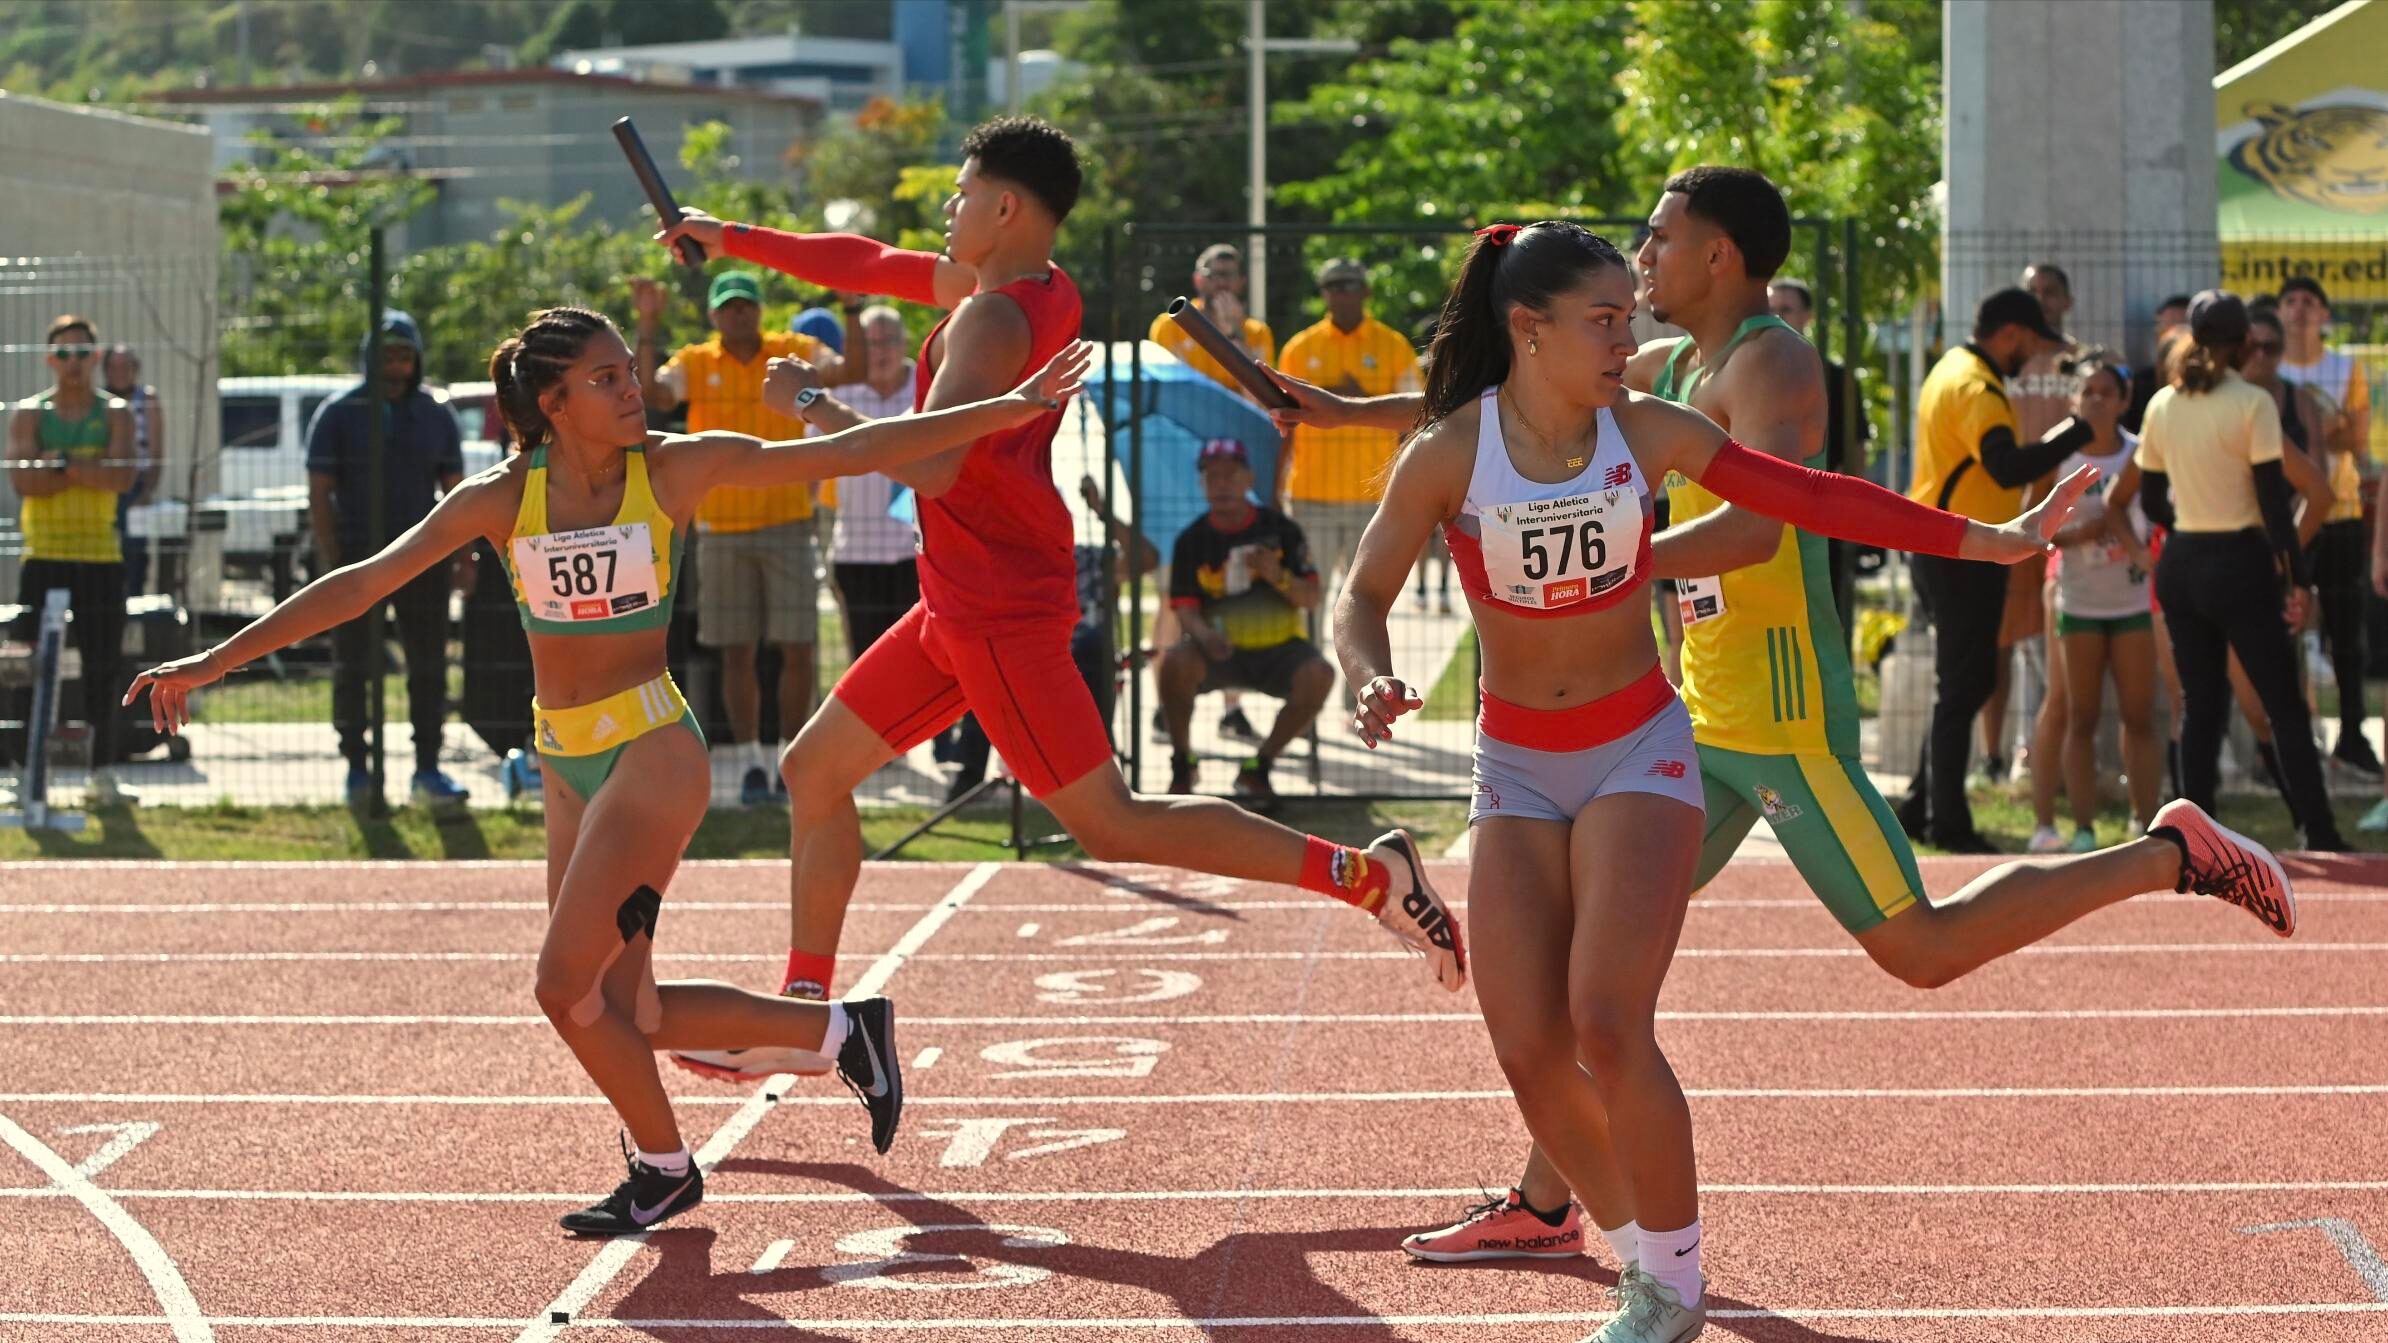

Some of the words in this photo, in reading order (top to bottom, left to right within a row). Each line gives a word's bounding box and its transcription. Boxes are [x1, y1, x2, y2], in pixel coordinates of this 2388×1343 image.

[1528, 502, 1550, 513] Liga
[1553, 497, 1589, 510] Atletica
[1517, 506, 1603, 525] Interuniversitaria
[544, 538, 617, 553] Interuniversitaria
[553, 534, 571, 542] Liga
[574, 530, 605, 539] Atletica
[1521, 520, 1607, 580] 576
[548, 550, 617, 597] 587
[1551, 589, 1580, 600] HORA
[1403, 892, 1456, 951] AIR
[1478, 1238, 1511, 1249] new
[1515, 1230, 1579, 1250] balance
